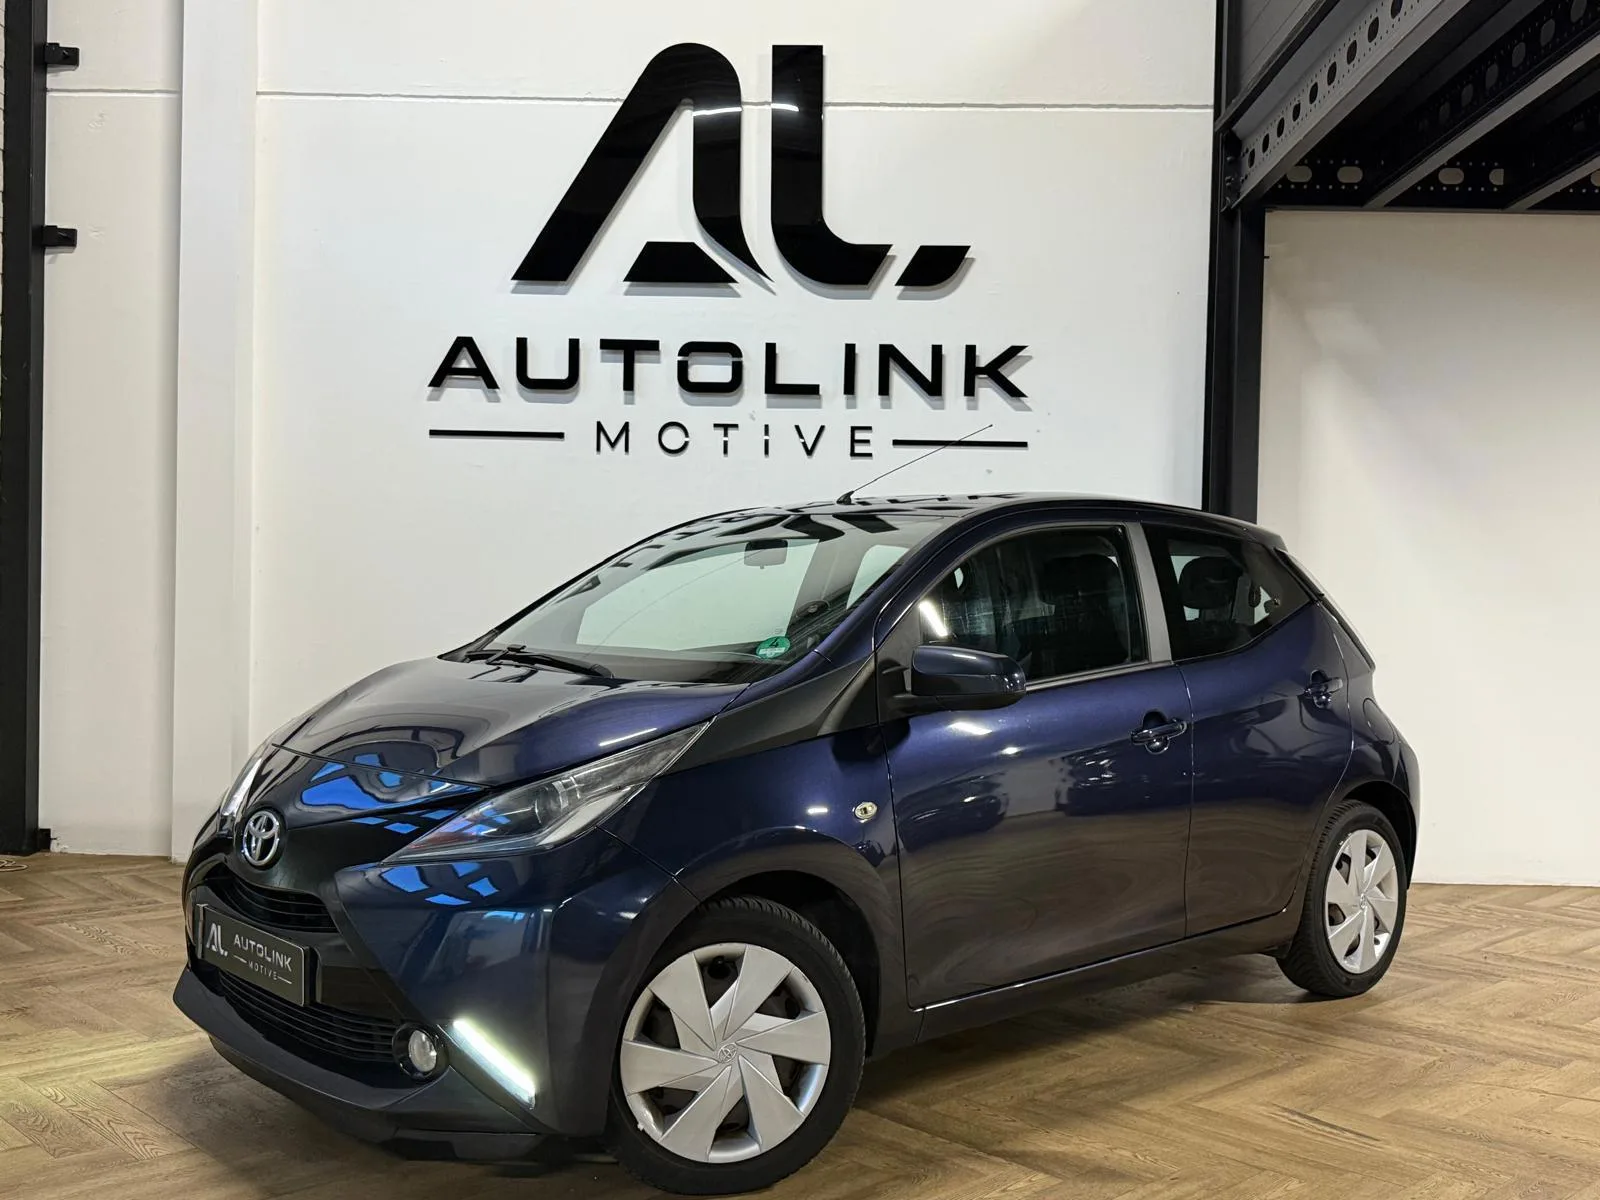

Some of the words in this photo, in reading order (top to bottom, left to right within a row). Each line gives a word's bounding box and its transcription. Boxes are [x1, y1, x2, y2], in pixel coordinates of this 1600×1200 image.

[427, 336, 1029, 399] AUTOLINK
[596, 421, 874, 458] MOTIVE
[769, 637, 779, 647] 4
[233, 934, 292, 972] AUTOLINK
[248, 961, 278, 980] MOTIVE
